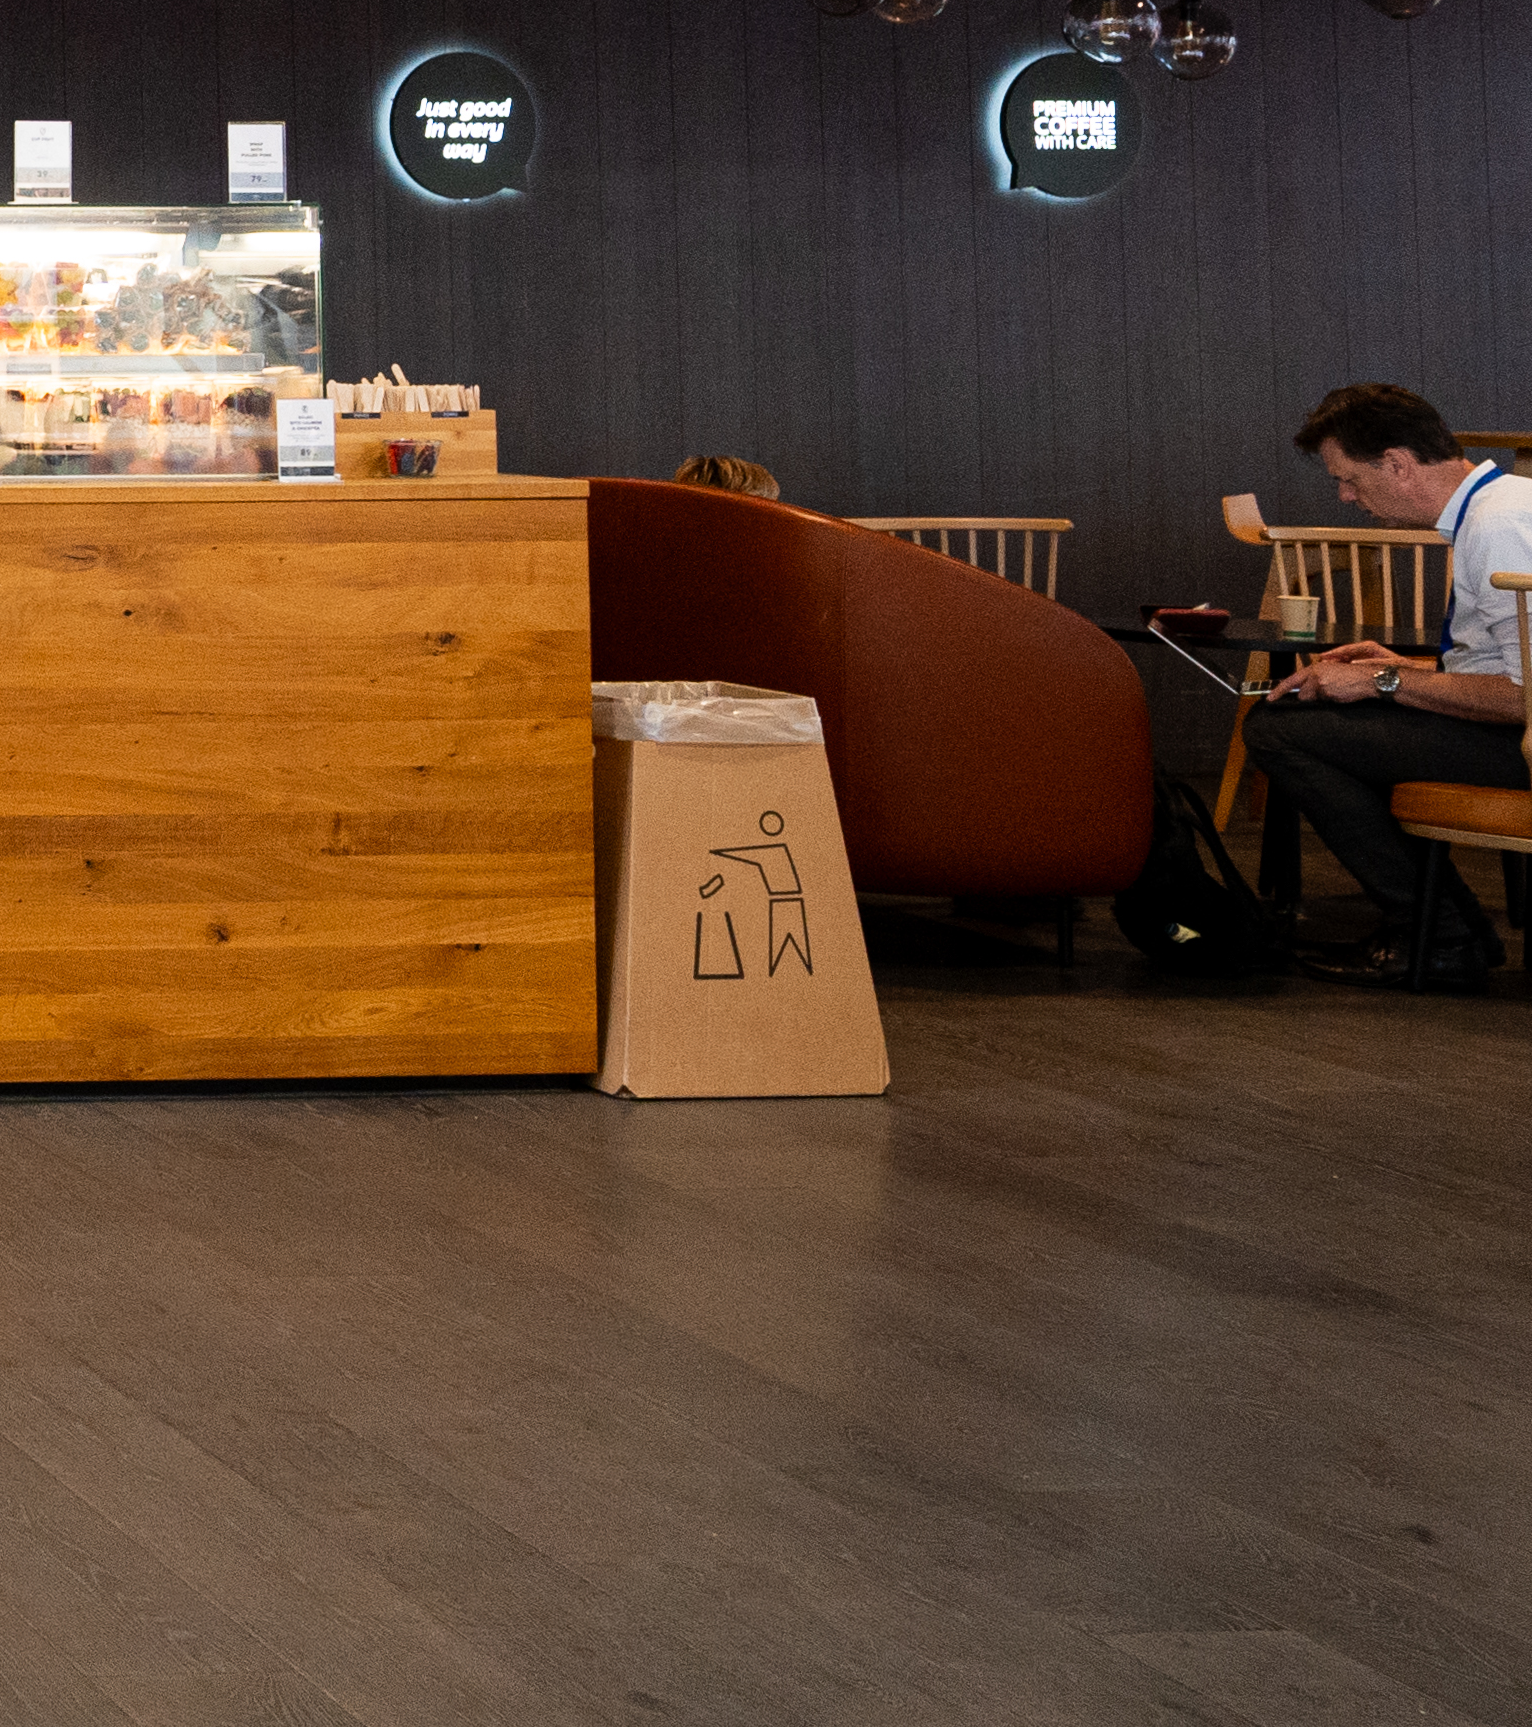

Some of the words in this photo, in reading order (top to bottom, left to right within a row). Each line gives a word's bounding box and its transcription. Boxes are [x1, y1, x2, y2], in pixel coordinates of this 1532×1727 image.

[416, 98, 458, 115] Just
[459, 98, 511, 121] good
[1033, 100, 1116, 117] PREMIUM
[425, 118, 445, 138] in
[447, 123, 504, 142] every
[1034, 116, 1115, 135] COFFEE
[1034, 134, 1075, 150] WITH
[1075, 134, 1117, 150] CARE
[443, 143, 487, 163] way
[250, 175, 262, 183] 79
